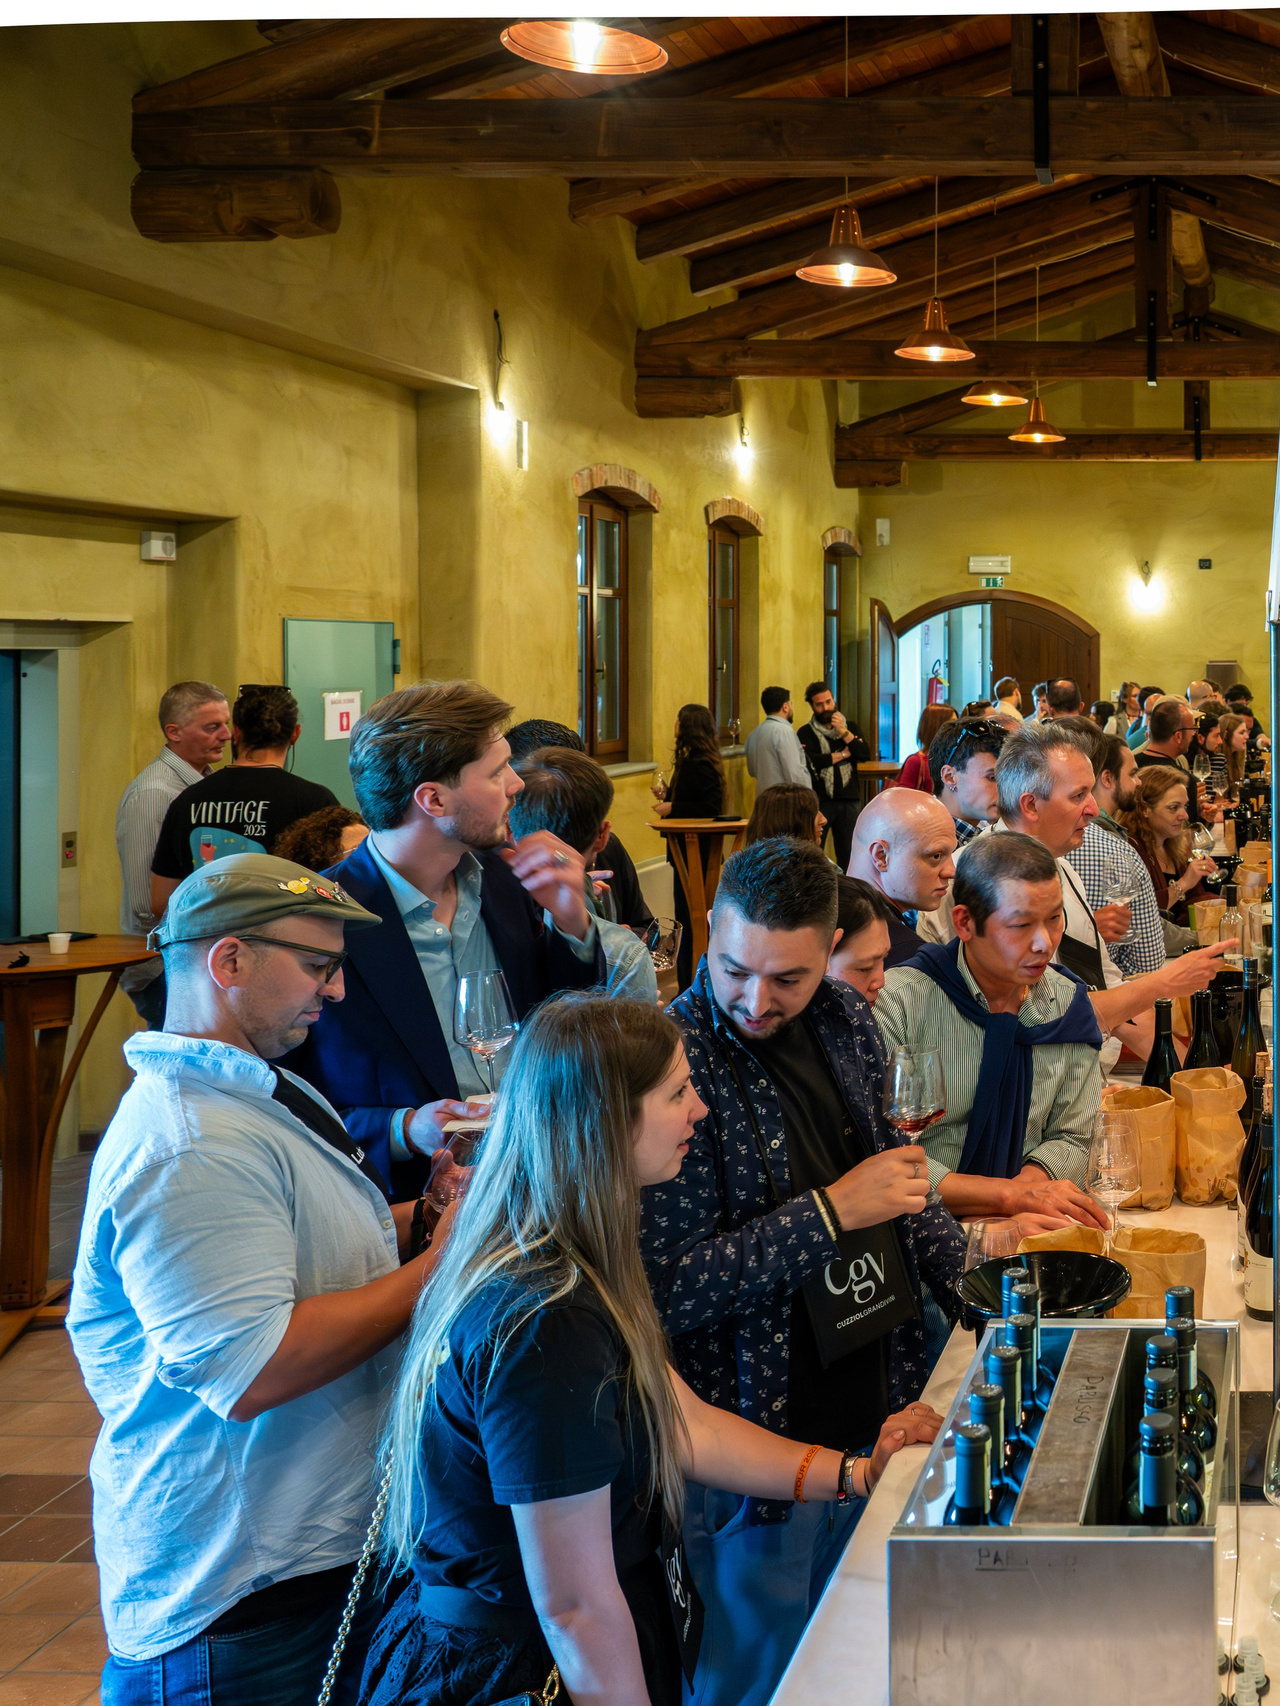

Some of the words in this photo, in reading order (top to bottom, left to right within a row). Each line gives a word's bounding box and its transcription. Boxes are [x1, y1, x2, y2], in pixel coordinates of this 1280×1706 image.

[191, 800, 271, 825] VINTAGE
[243, 824, 267, 836] 2025
[795, 1464, 807, 1492] TOUR
